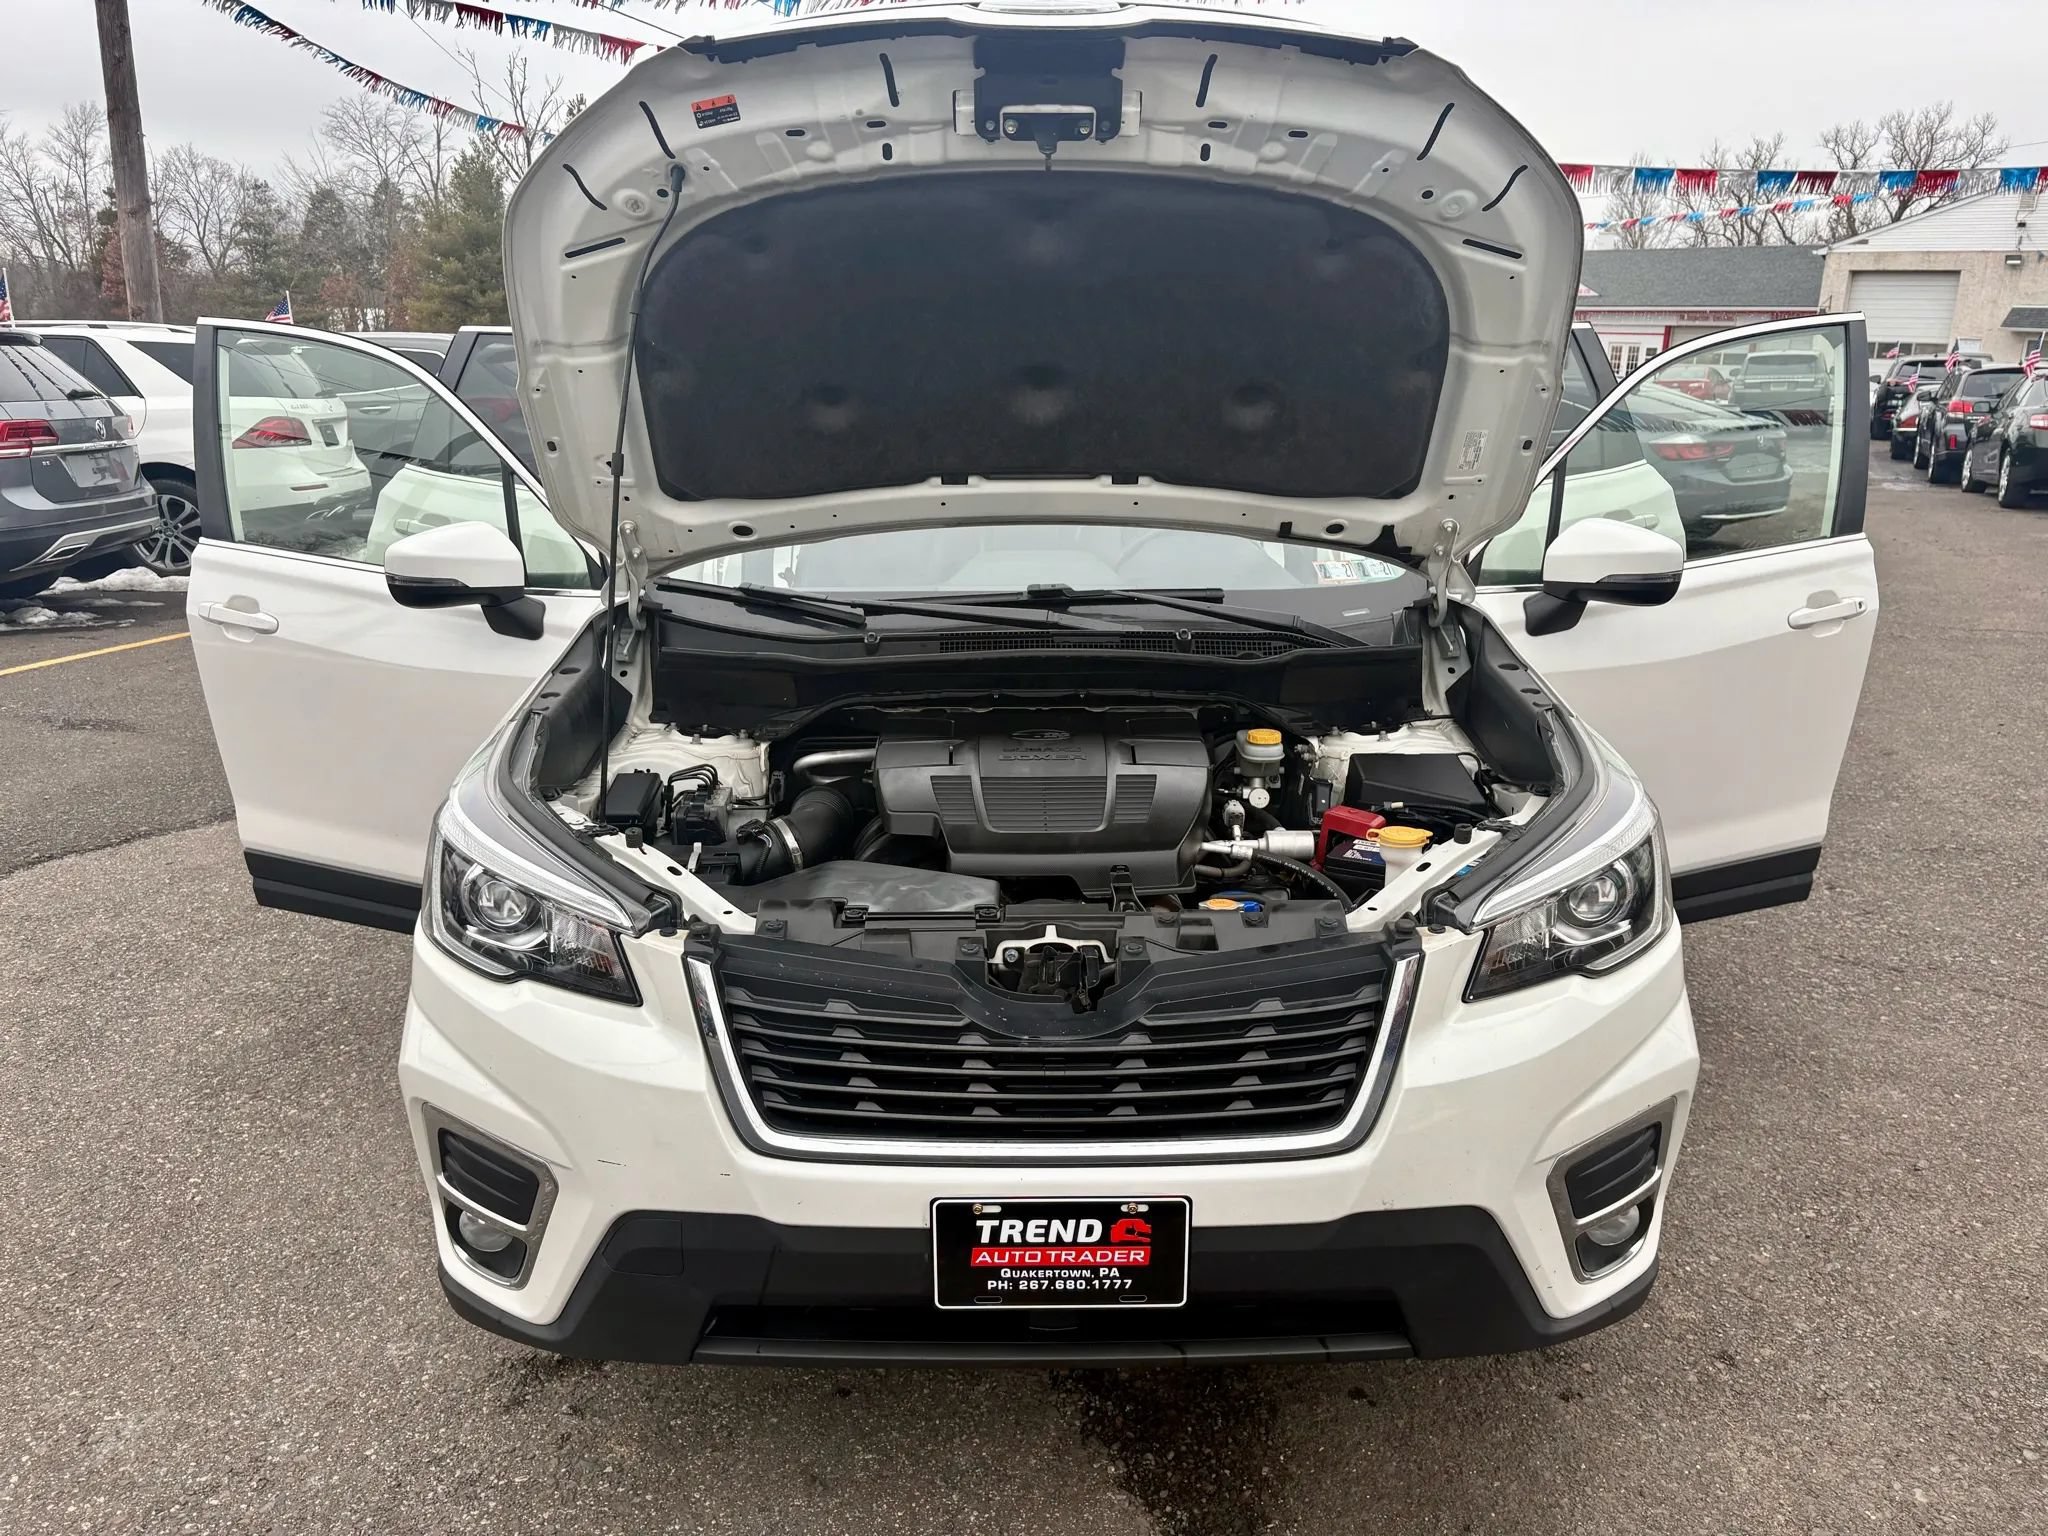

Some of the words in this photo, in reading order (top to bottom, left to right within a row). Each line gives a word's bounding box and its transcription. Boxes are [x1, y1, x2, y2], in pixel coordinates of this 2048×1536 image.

[998, 752, 1088, 761] BOXER
[975, 1218, 1103, 1244] TREND
[1000, 1267, 1095, 1279] QUAKERTOWN,
[1099, 1267, 1120, 1278] PA
[987, 1280, 1013, 1290] PH:
[1018, 1279, 1133, 1290] 267.680.1777
